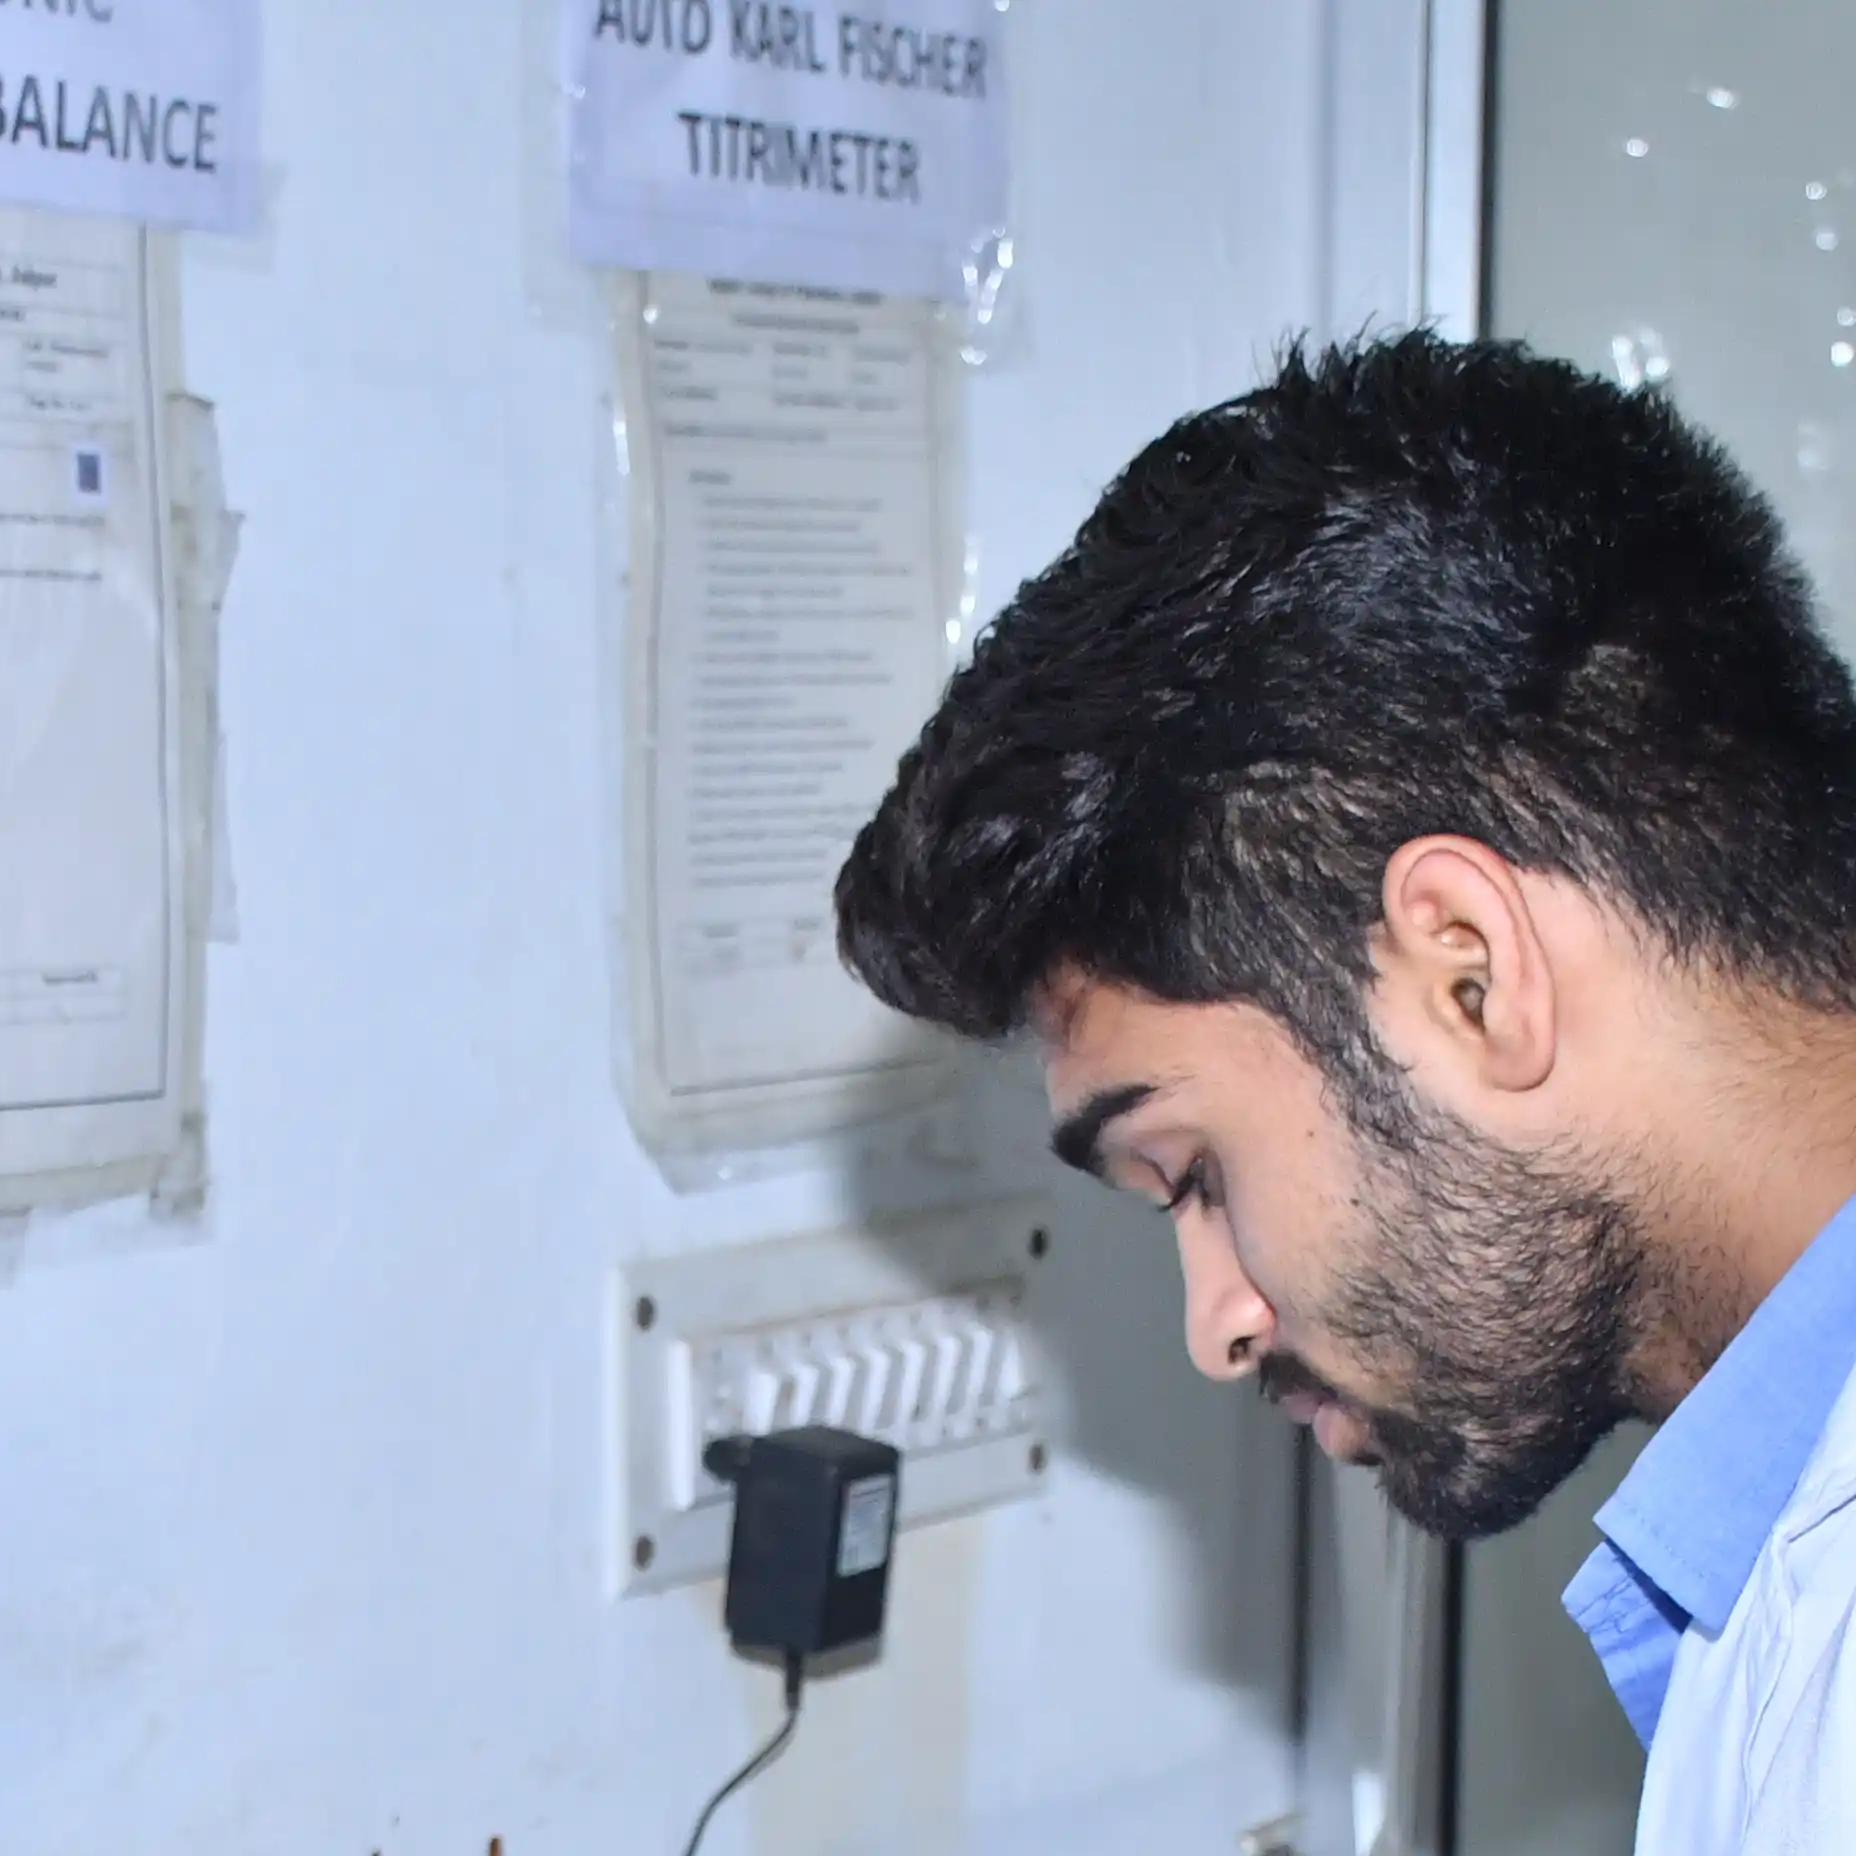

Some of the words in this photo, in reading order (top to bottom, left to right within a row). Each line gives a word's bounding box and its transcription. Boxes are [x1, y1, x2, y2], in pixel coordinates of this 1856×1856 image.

[593, 0, 713, 54] AUTO
[730, 1, 826, 72] KARL
[838, 14, 988, 99] FISCHER
[676, 110, 921, 204] TITRIMETER
